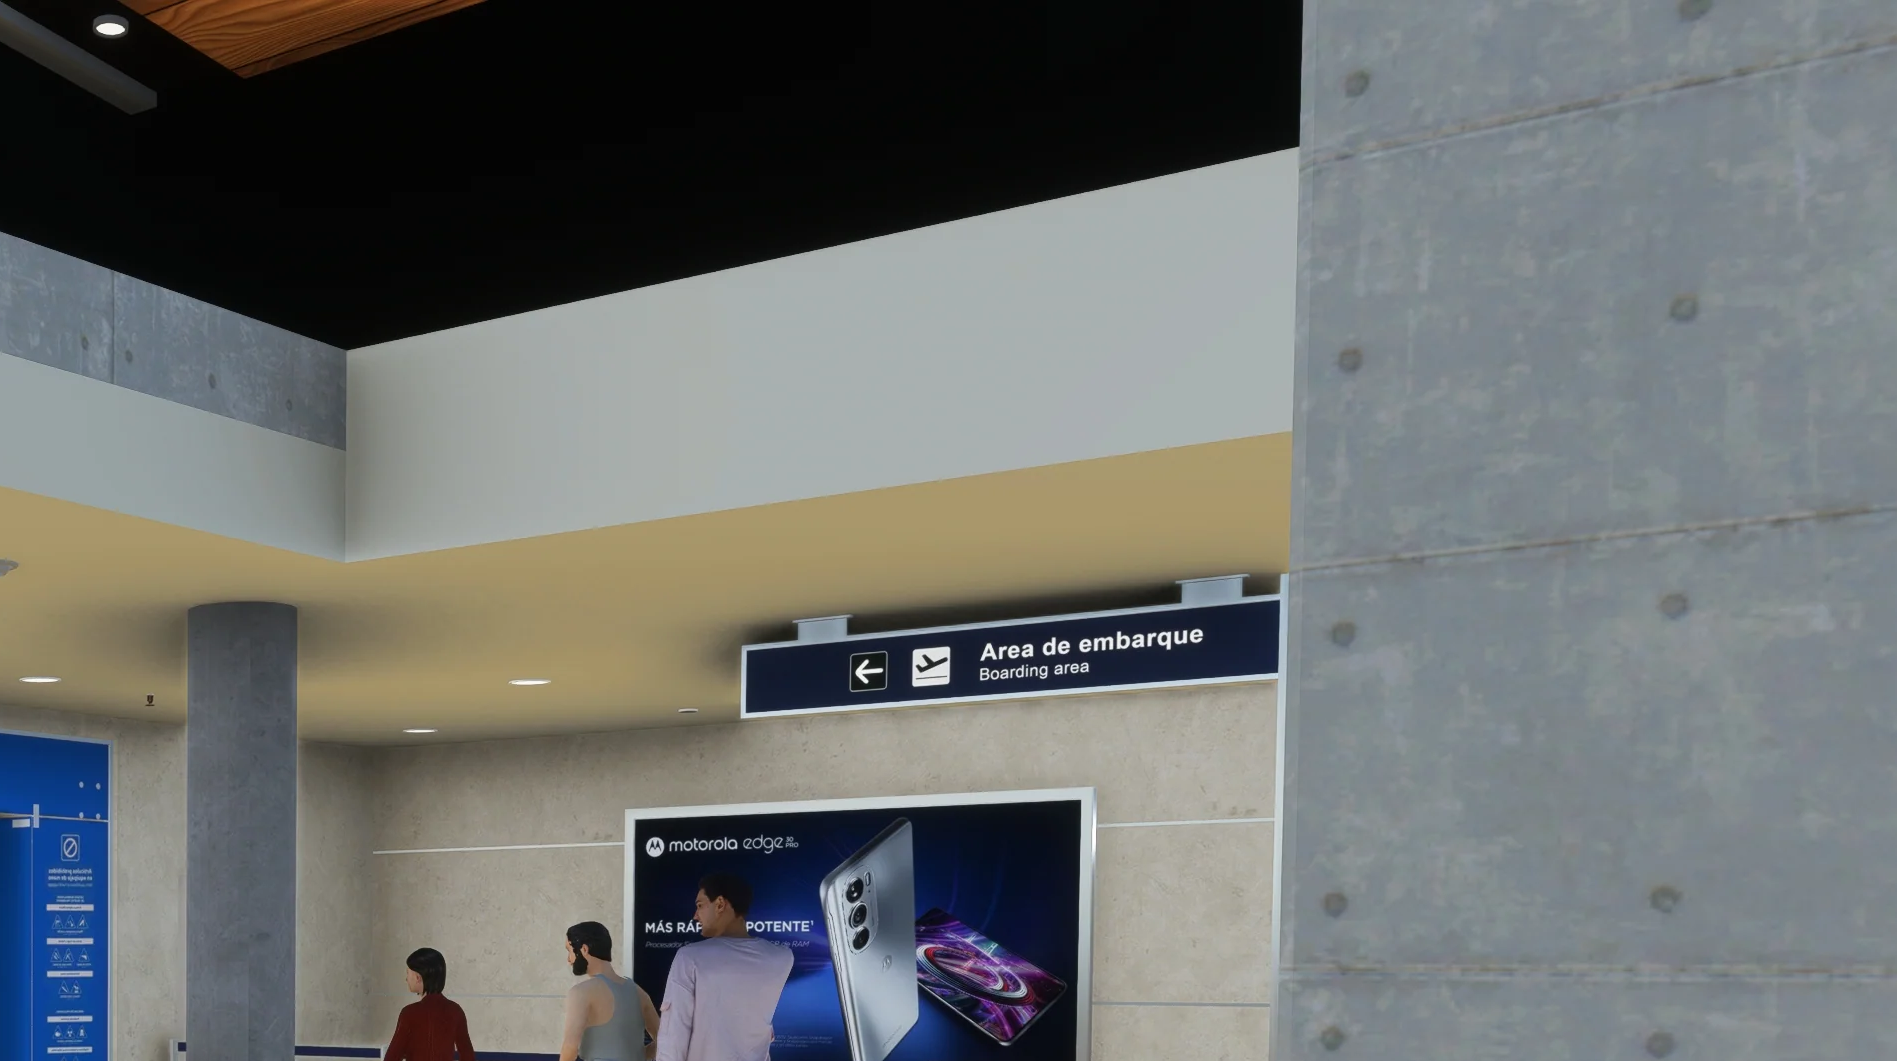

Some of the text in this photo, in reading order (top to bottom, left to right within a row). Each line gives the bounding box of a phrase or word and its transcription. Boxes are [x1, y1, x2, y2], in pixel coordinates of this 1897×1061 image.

[980, 628, 1204, 661] Area de embarque
[979, 662, 1090, 681] Boarding area
[669, 834, 784, 854] motorola edge
[645, 920, 673, 933] MÁS
[791, 940, 810, 948] RAM
